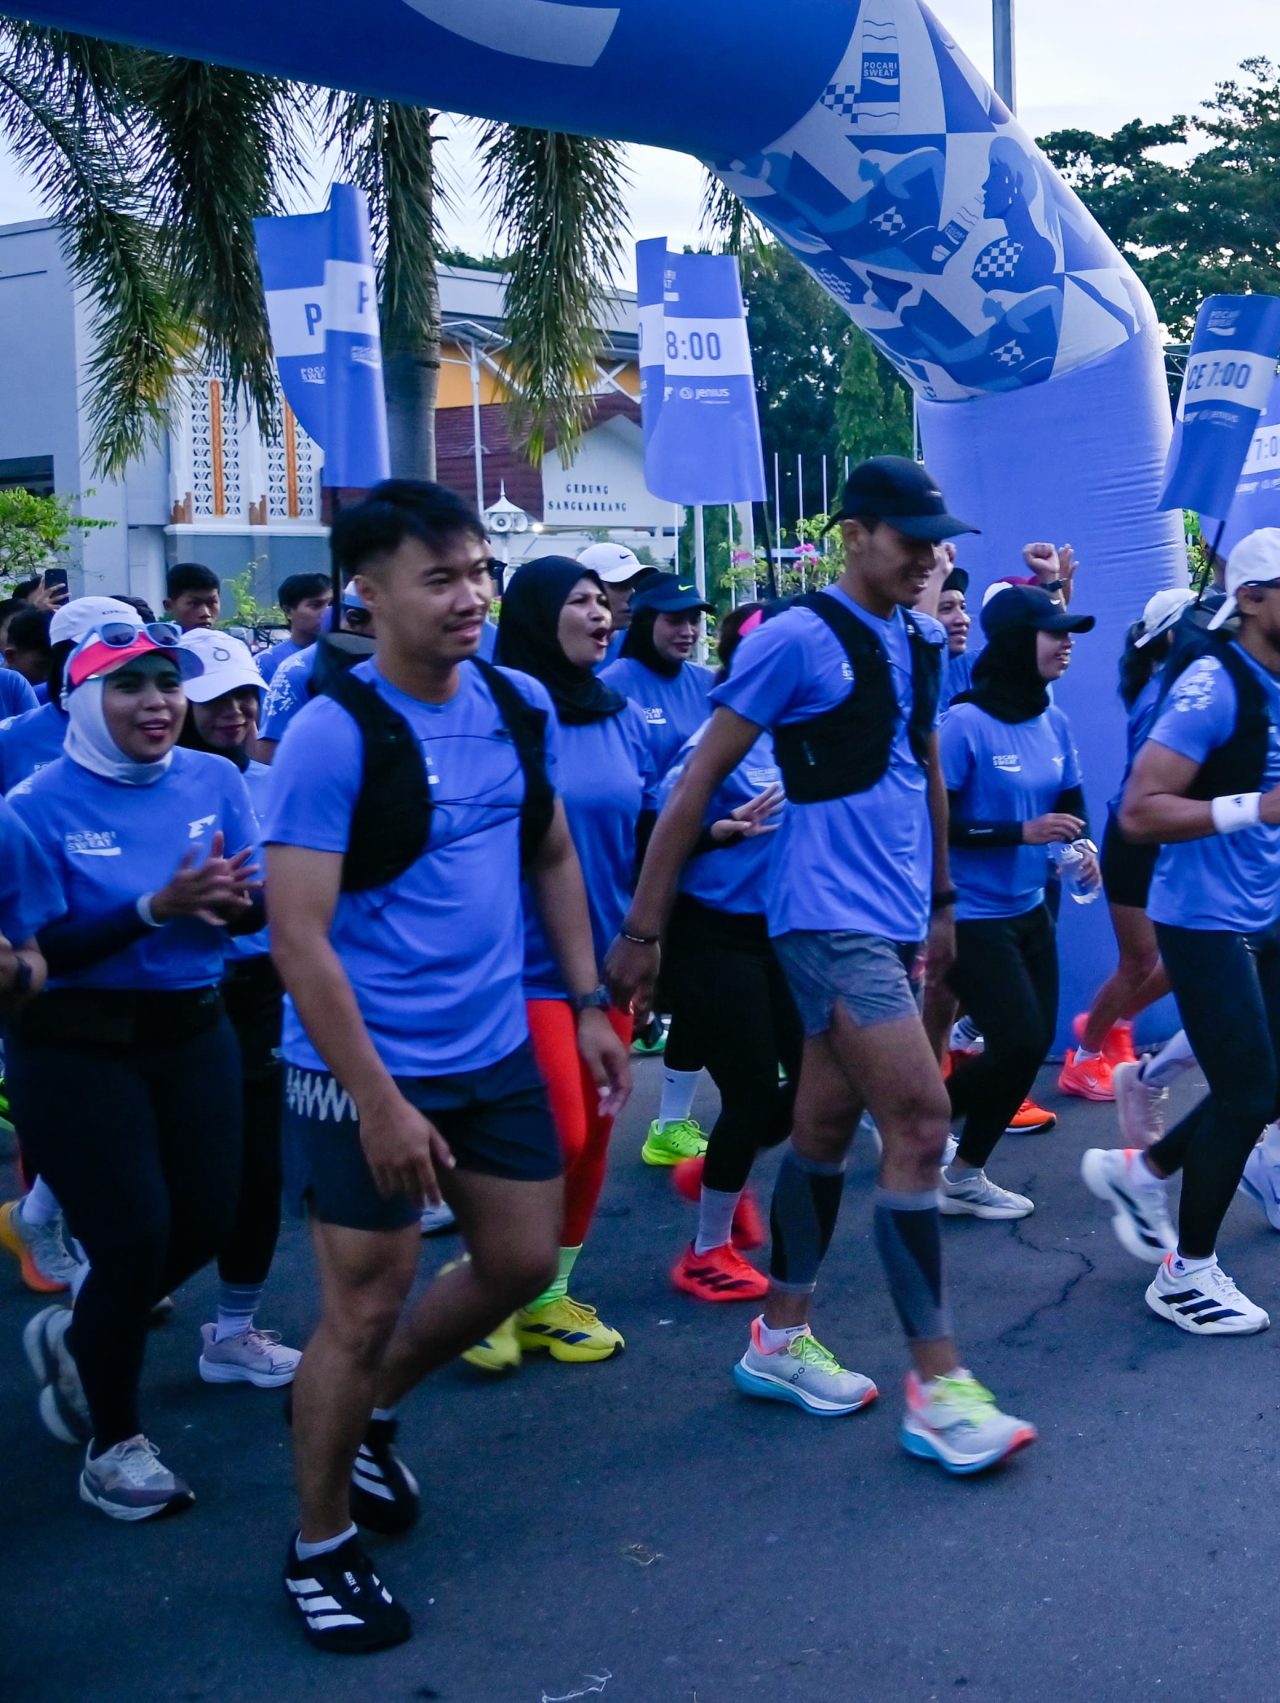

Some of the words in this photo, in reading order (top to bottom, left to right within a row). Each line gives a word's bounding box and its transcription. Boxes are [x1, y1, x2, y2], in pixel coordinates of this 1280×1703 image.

[863, 61, 897, 70] POCARI
[863, 69, 895, 77] SWEAT
[665, 330, 721, 361] 8:00
[1208, 361, 1252, 389] 7:00
